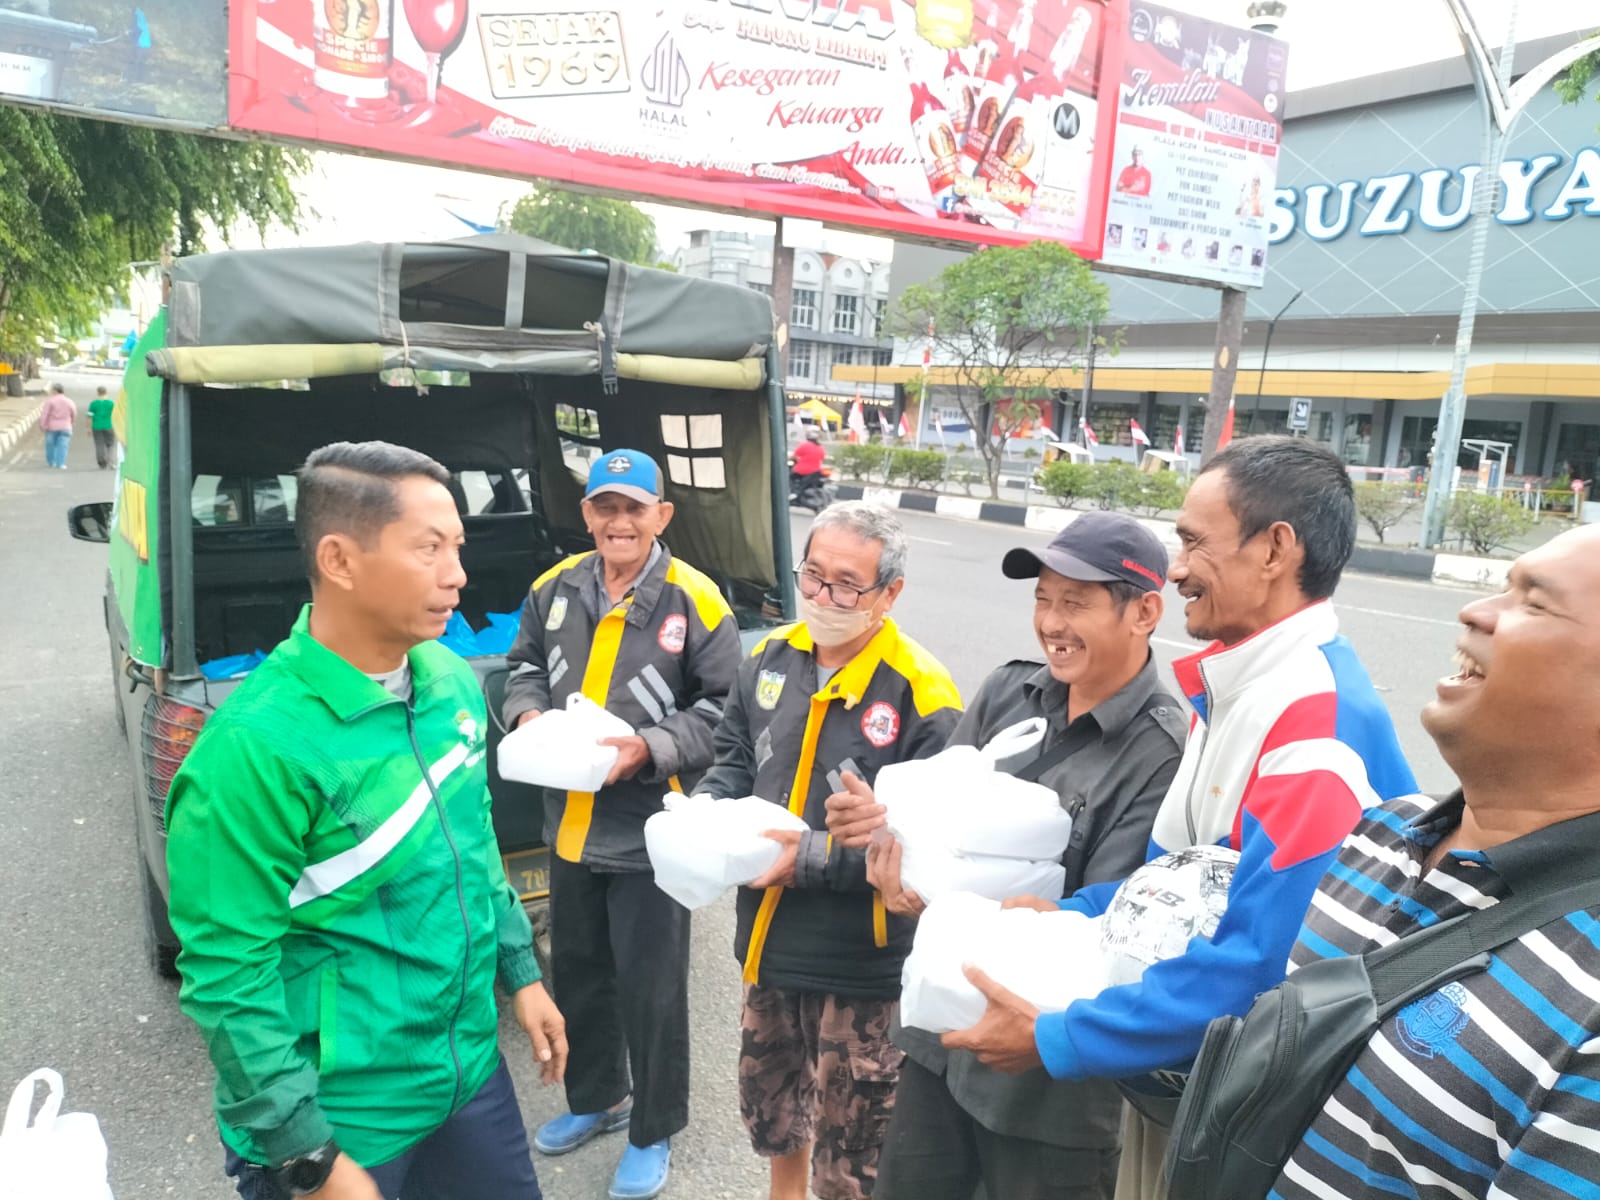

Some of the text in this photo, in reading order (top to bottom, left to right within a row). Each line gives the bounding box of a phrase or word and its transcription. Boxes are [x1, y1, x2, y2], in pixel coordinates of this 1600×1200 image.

[488, 17, 617, 48] SEJAK
[496, 51, 621, 89] 1969
[698, 61, 841, 96] Kesegaran
[639, 107, 688, 128] HALAL
[767, 99, 884, 134] Keluarga
[1205, 109, 1277, 142] NUSANTARA
[1267, 147, 1600, 245] SUZUYA
